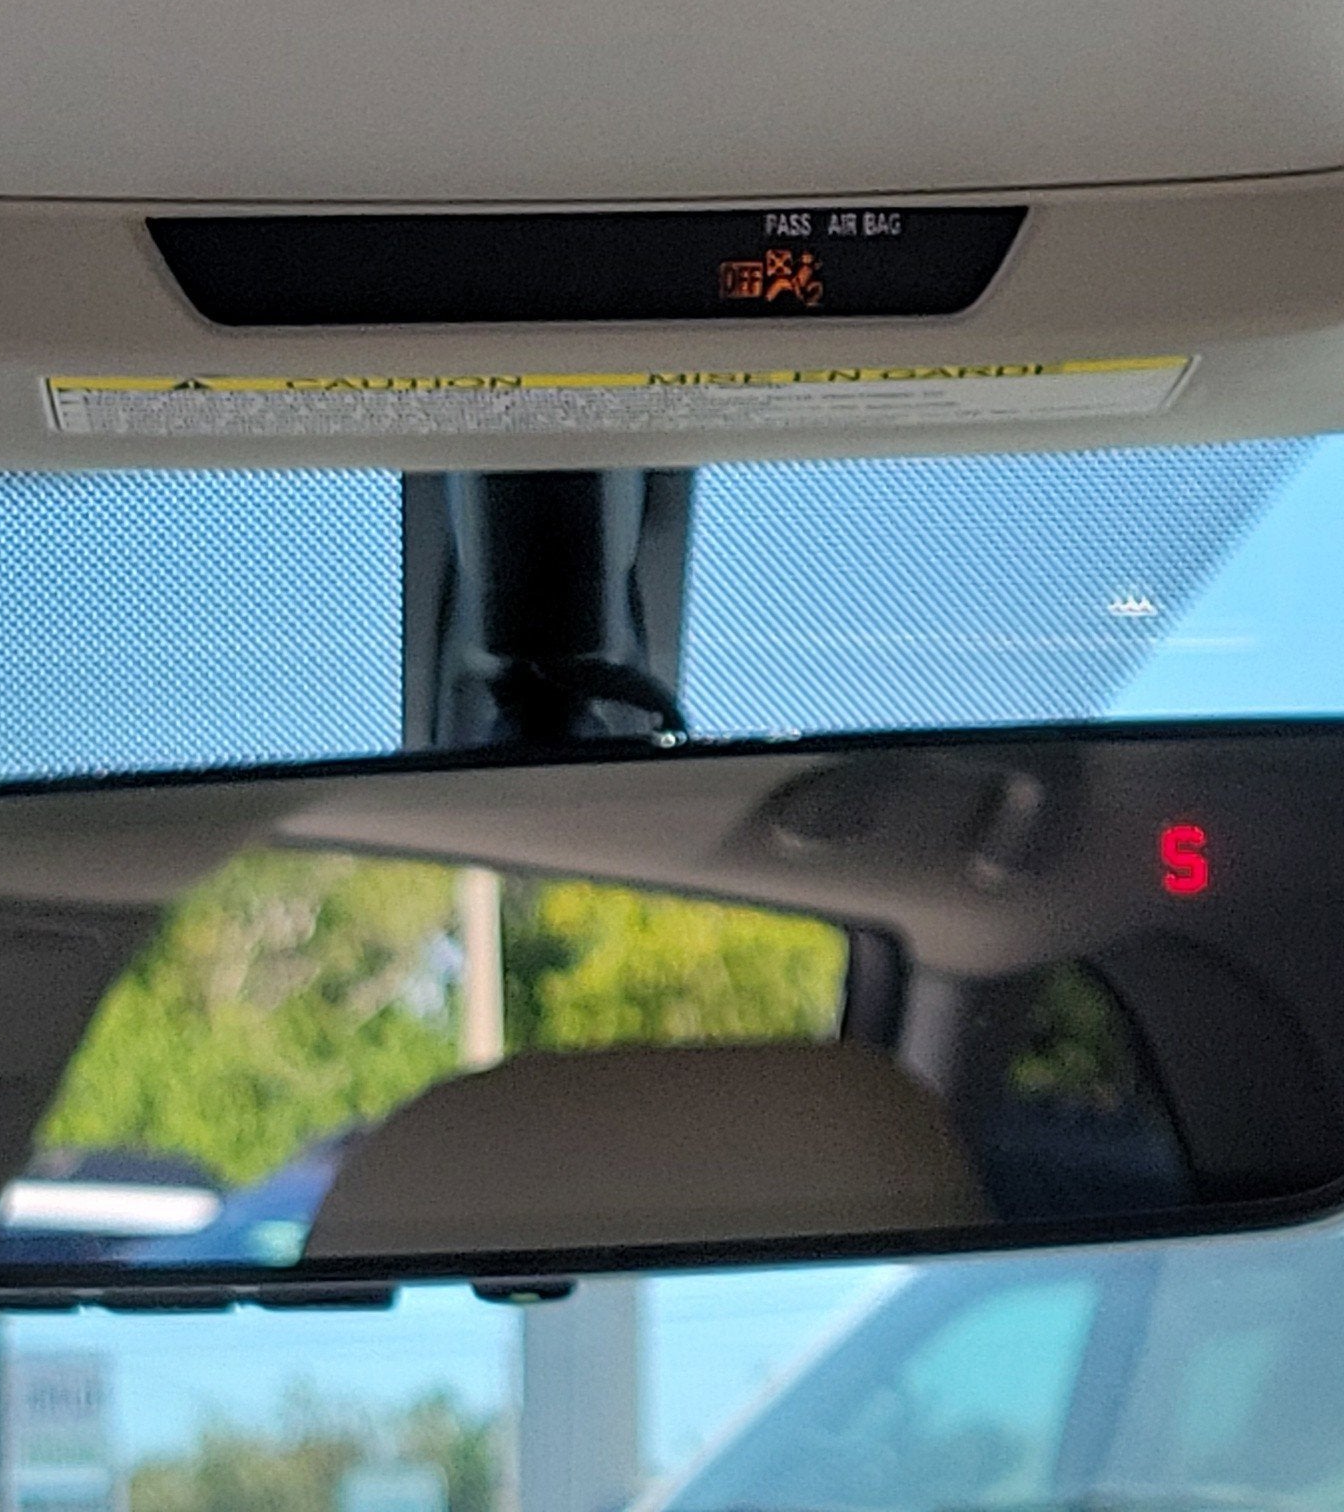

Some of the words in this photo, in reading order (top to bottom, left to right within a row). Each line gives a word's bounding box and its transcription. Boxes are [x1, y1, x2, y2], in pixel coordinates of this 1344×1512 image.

[765, 213, 812, 236] PASS
[827, 213, 856, 235] AIR
[862, 212, 902, 236] BAG
[286, 376, 523, 391] CAUTION
[1161, 824, 1209, 894] S
